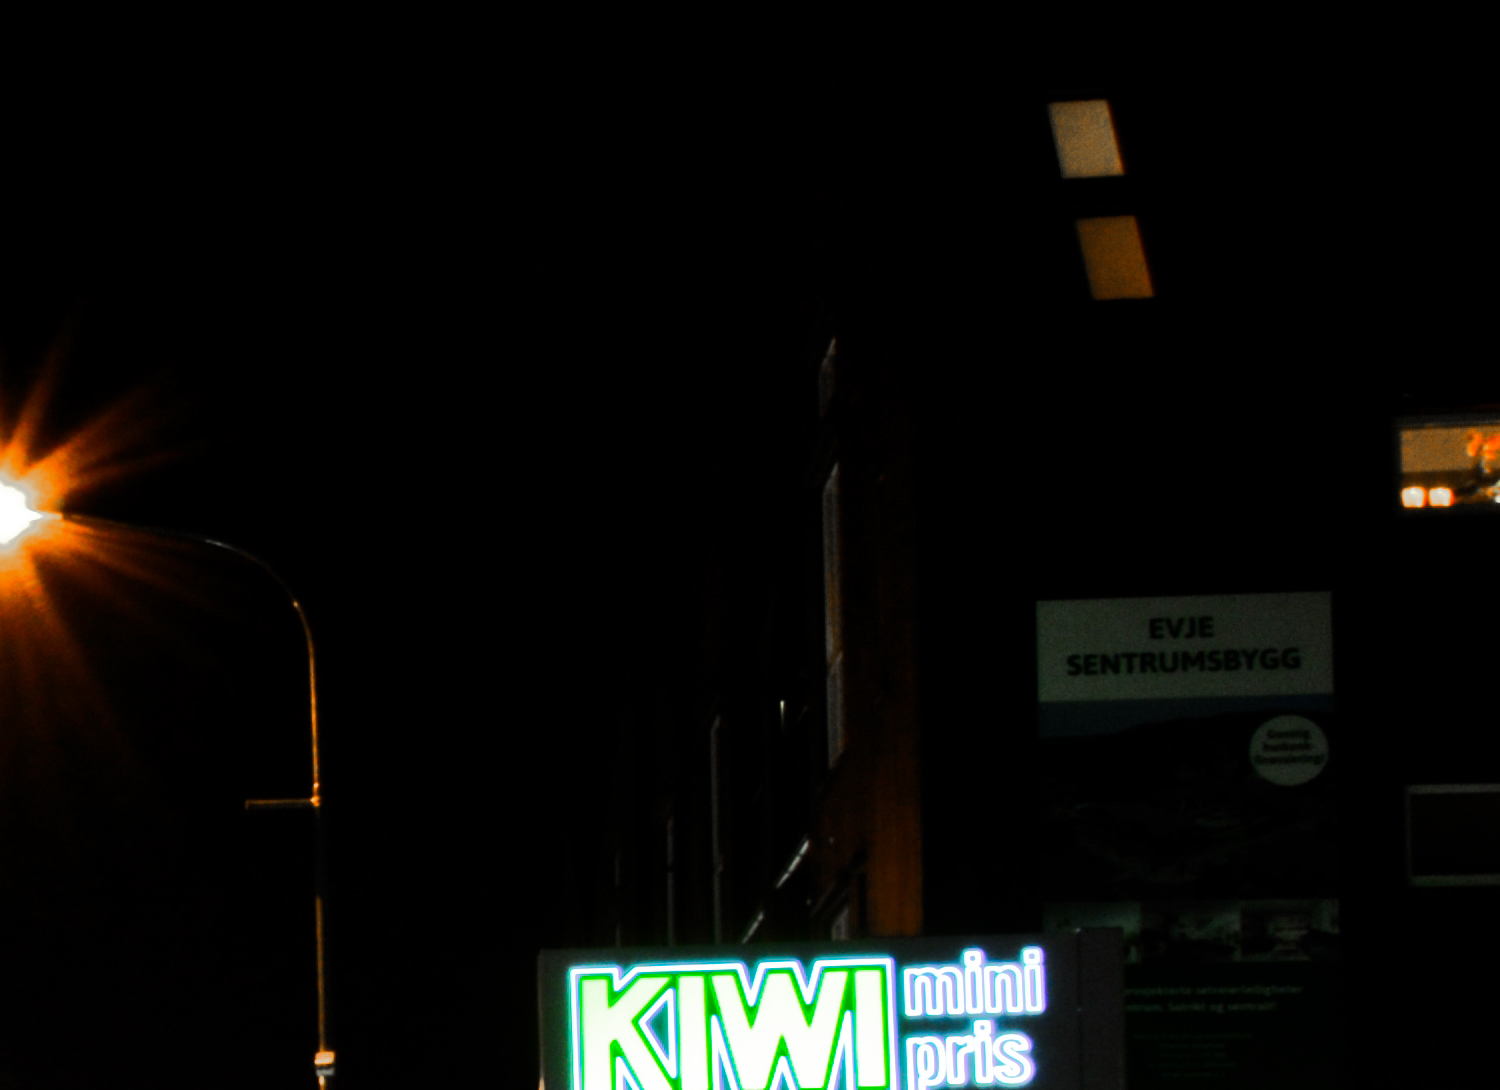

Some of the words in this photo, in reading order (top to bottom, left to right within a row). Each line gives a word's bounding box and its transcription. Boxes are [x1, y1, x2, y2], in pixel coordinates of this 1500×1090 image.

[1150, 616, 1214, 639] EVJE
[1067, 647, 1302, 676] SENTRUMSBYGG
[903, 947, 1047, 1017] mini
